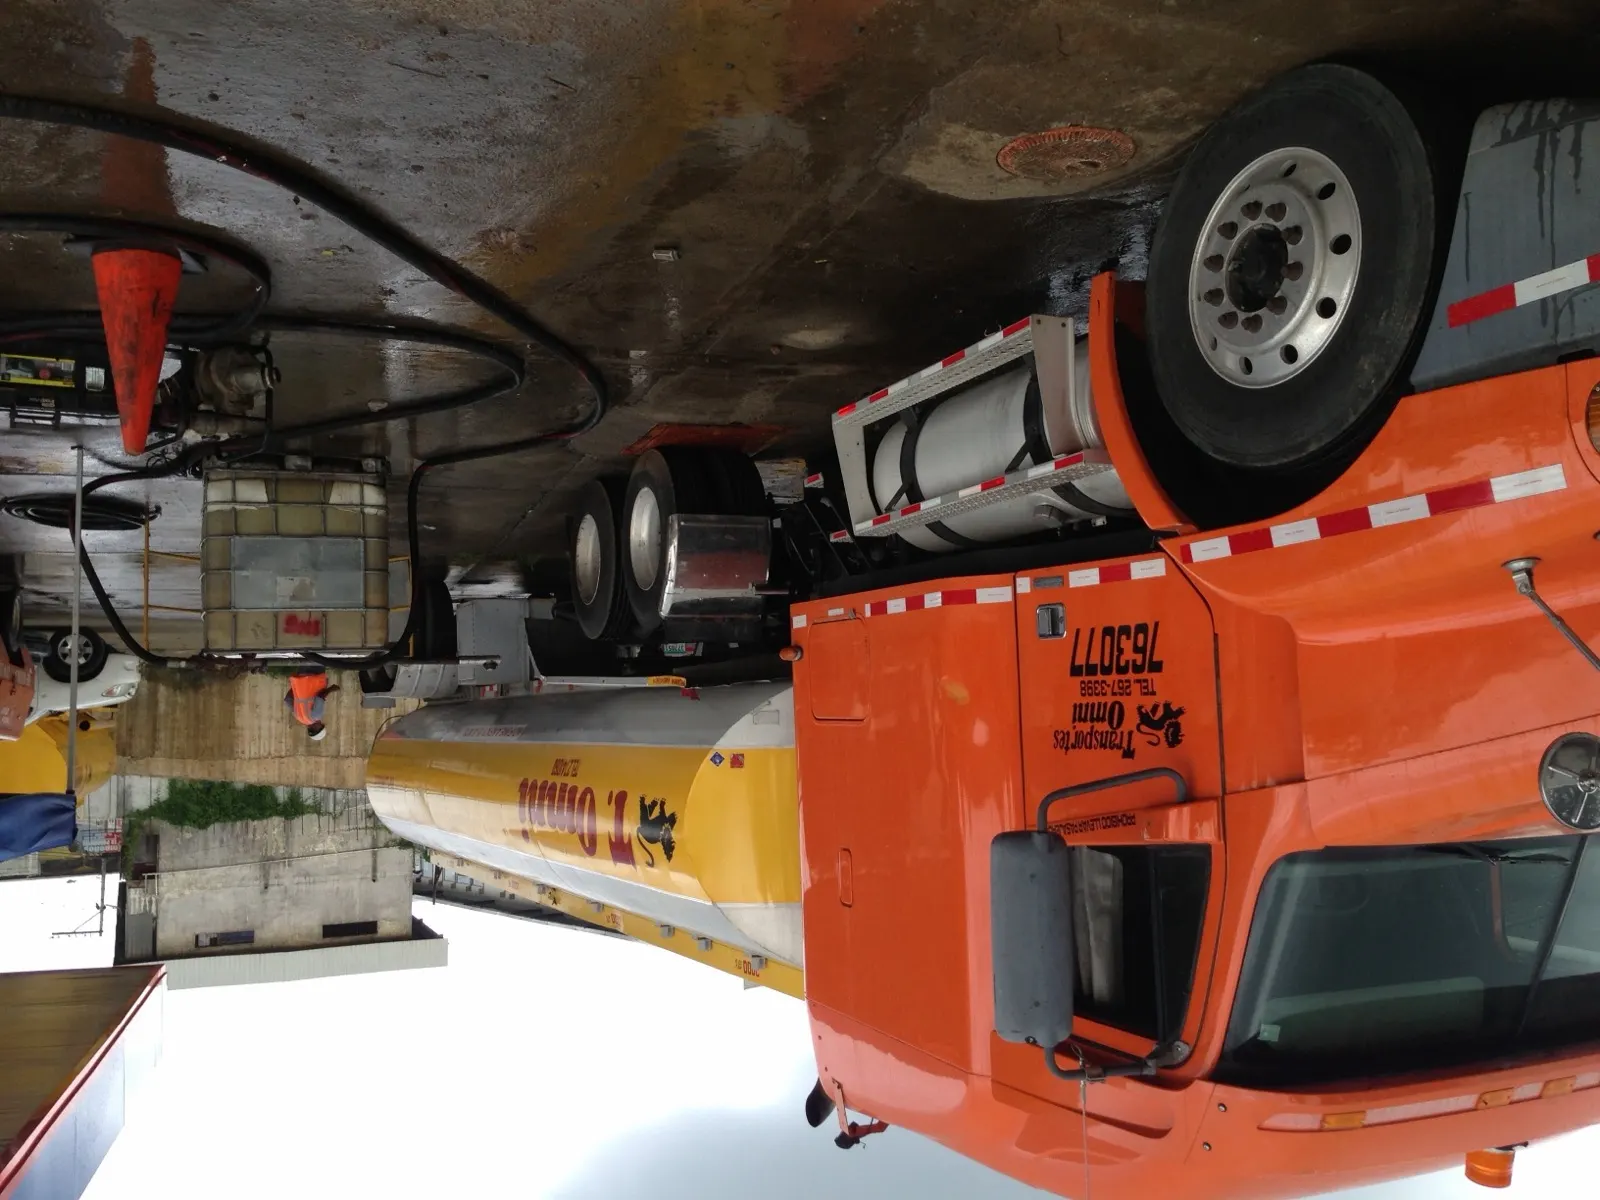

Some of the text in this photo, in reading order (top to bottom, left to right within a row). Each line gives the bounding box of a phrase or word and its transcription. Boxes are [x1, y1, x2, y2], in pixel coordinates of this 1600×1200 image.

[1070, 621, 1163, 677] 763077
[1080, 678, 1156, 696] TEL. 267-3398
[1072, 701, 1124, 730] Omni
[1054, 725, 1136, 760] Transportes
[518, 778, 637, 872] T. Omni
[1102, 813, 1136, 829] PROHIBIDO
